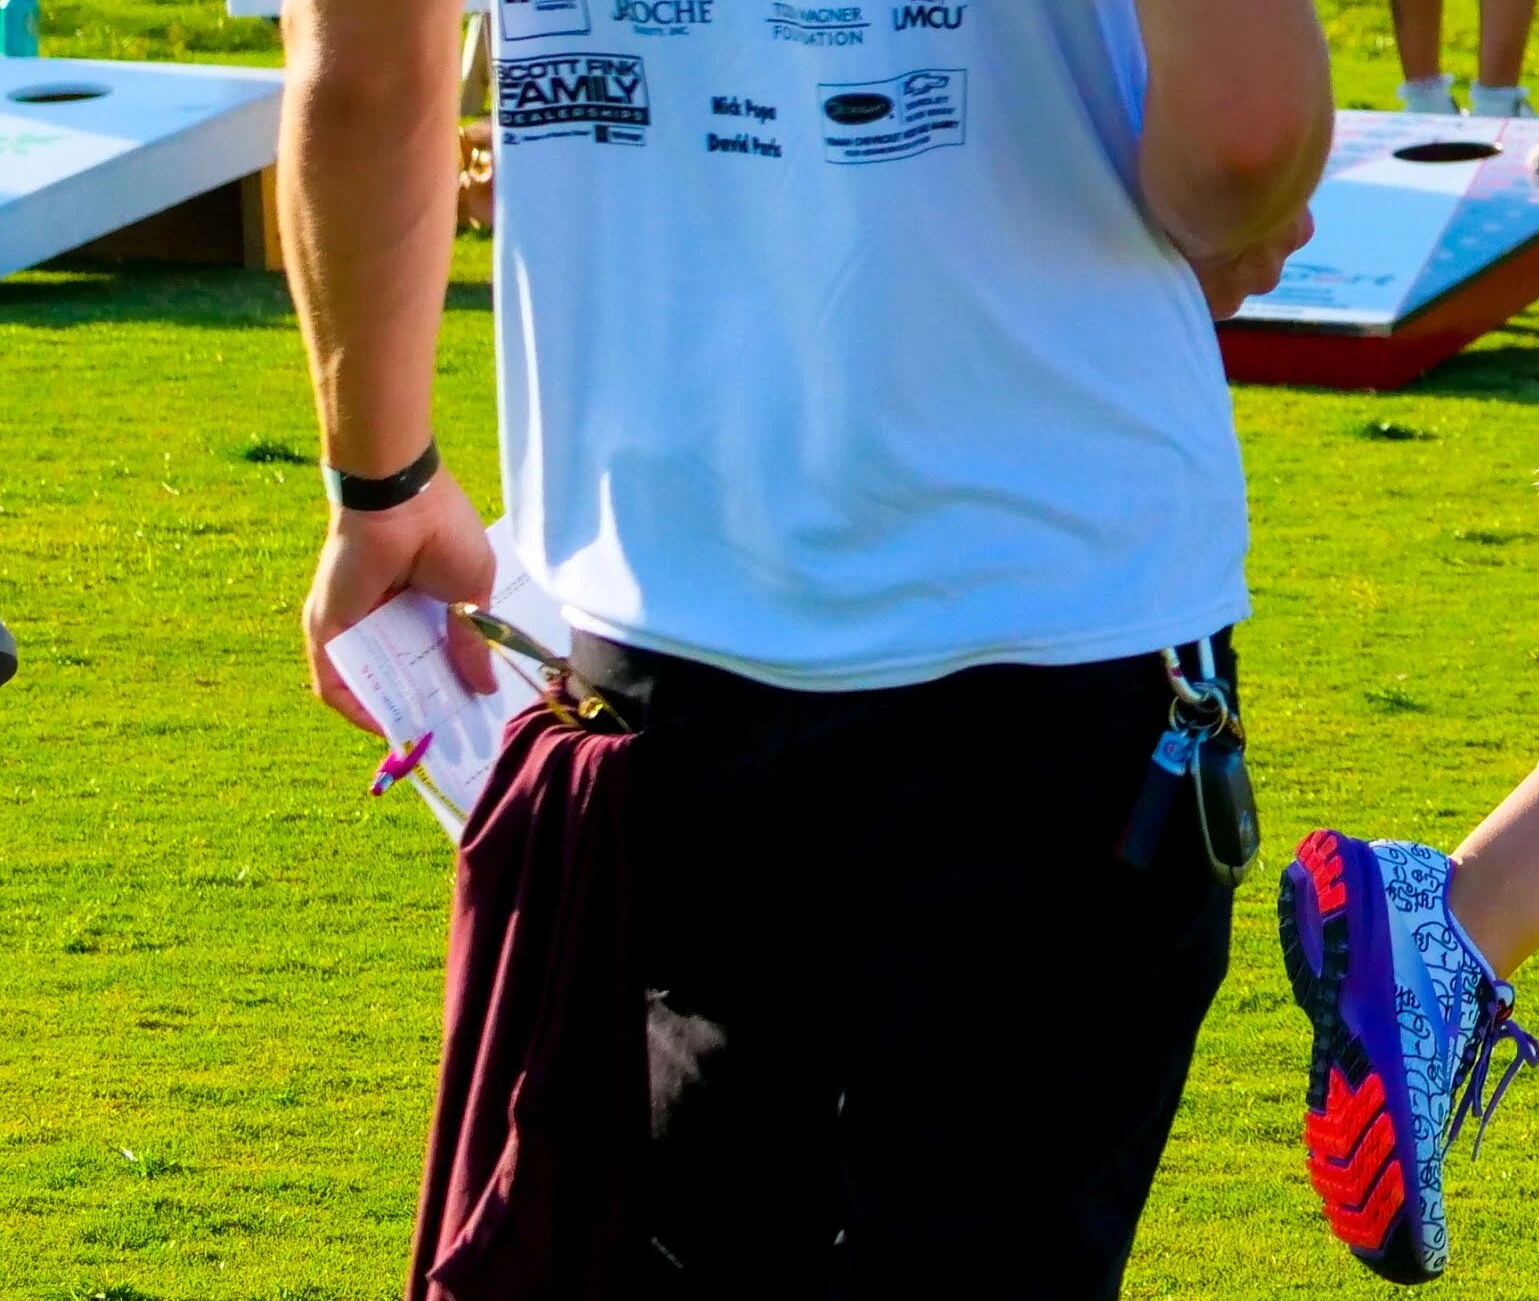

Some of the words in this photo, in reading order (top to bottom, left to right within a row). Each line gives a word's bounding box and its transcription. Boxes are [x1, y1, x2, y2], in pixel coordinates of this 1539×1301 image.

[497, 59, 579, 81] SCOTT
[499, 75, 640, 108] FAMILY
[500, 108, 643, 125] DEALERSHIPS
